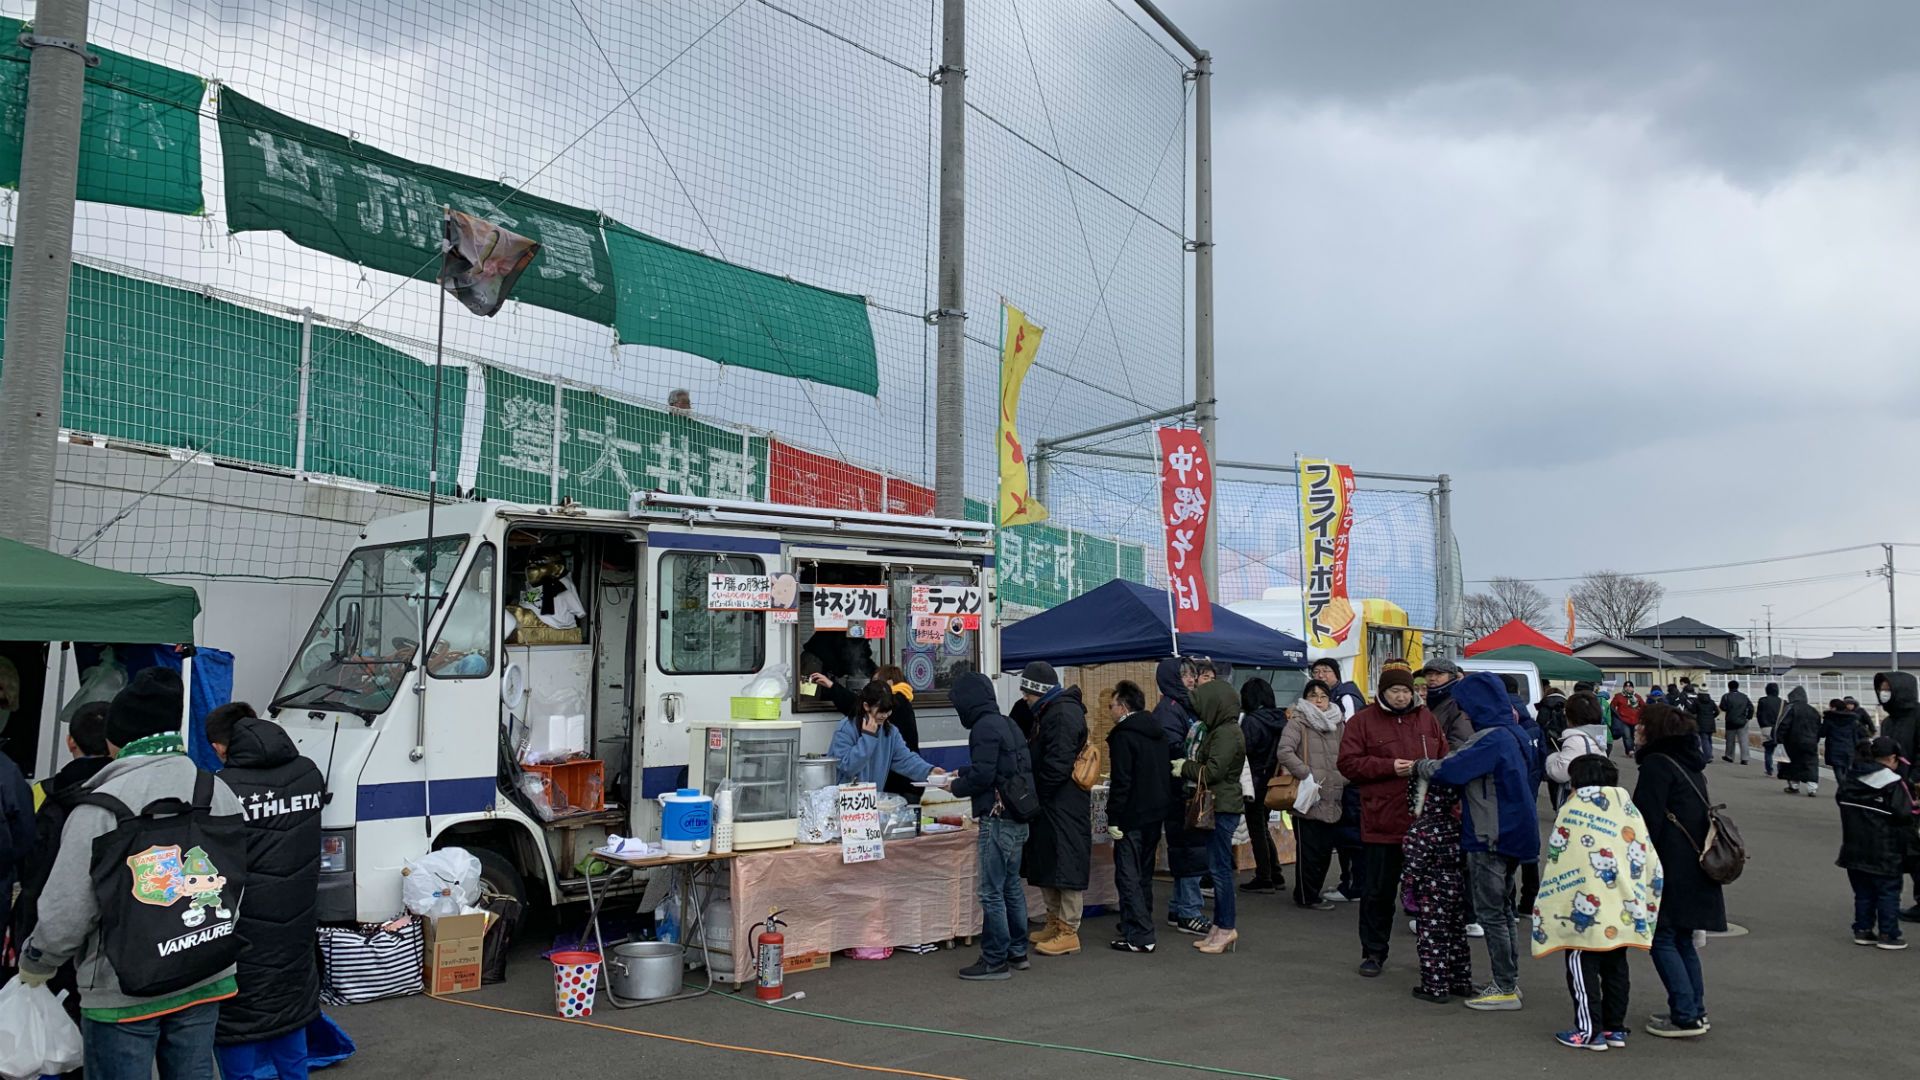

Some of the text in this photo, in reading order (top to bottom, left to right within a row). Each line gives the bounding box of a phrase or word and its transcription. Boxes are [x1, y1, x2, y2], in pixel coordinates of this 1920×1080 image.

[1307, 463, 1337, 643] フライドポテト
[1335, 533, 1348, 586] ホクホク
[928, 588, 981, 614] ラーメン
[1569, 809, 1617, 828] HELLO KITTY
[865, 827, 880, 840] ¥500
[1586, 823, 1618, 838] TOHOKU
[1558, 868, 1580, 880] KITTY
[157, 923, 232, 957] VANRAURE
